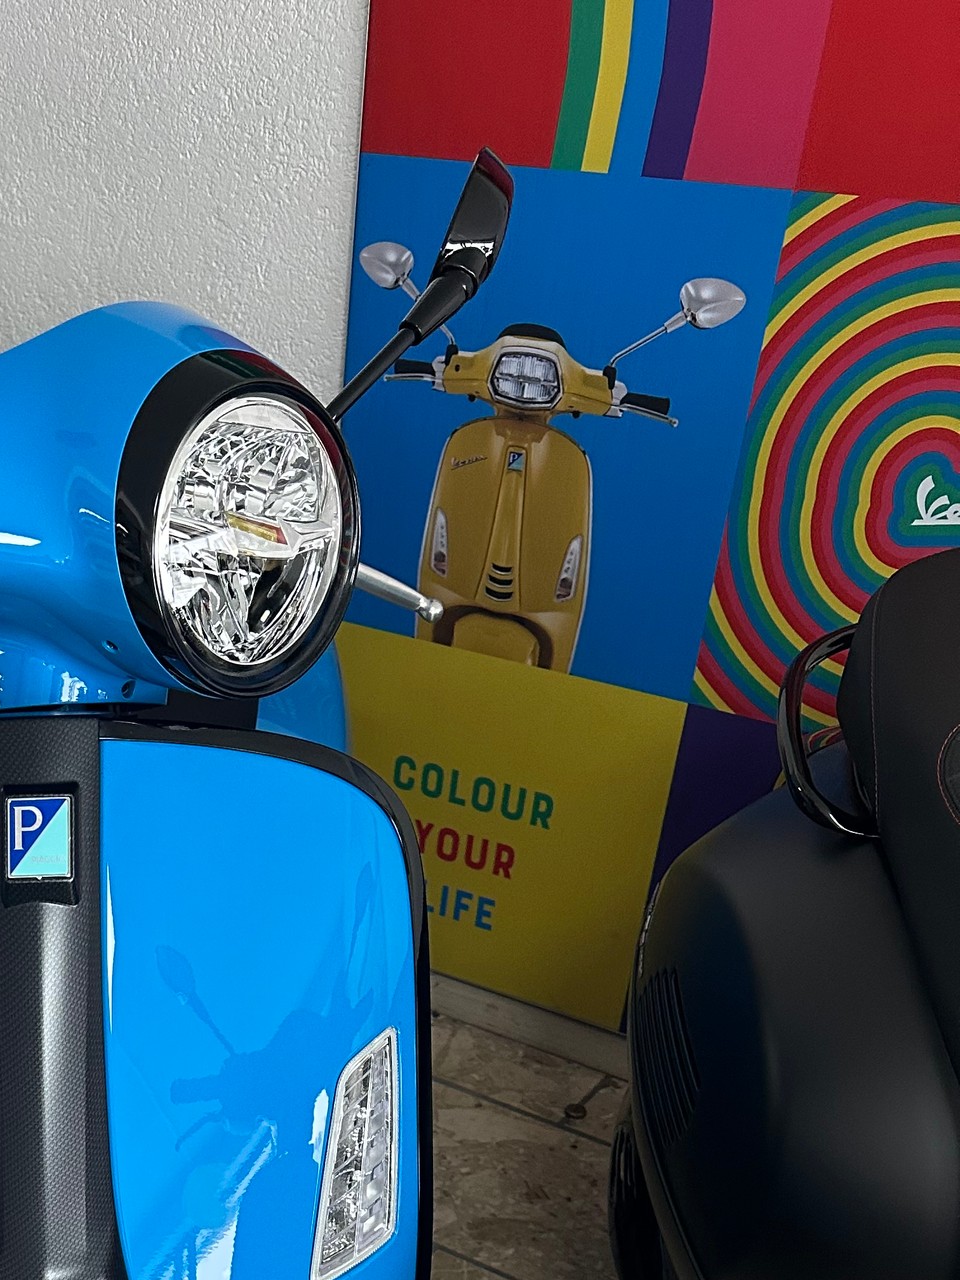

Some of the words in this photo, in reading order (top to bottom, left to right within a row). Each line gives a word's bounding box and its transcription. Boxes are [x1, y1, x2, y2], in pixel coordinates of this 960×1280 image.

[393, 755, 554, 830] COLOUR
[13, 805, 44, 851] P
[415, 819, 516, 880] YOUR
